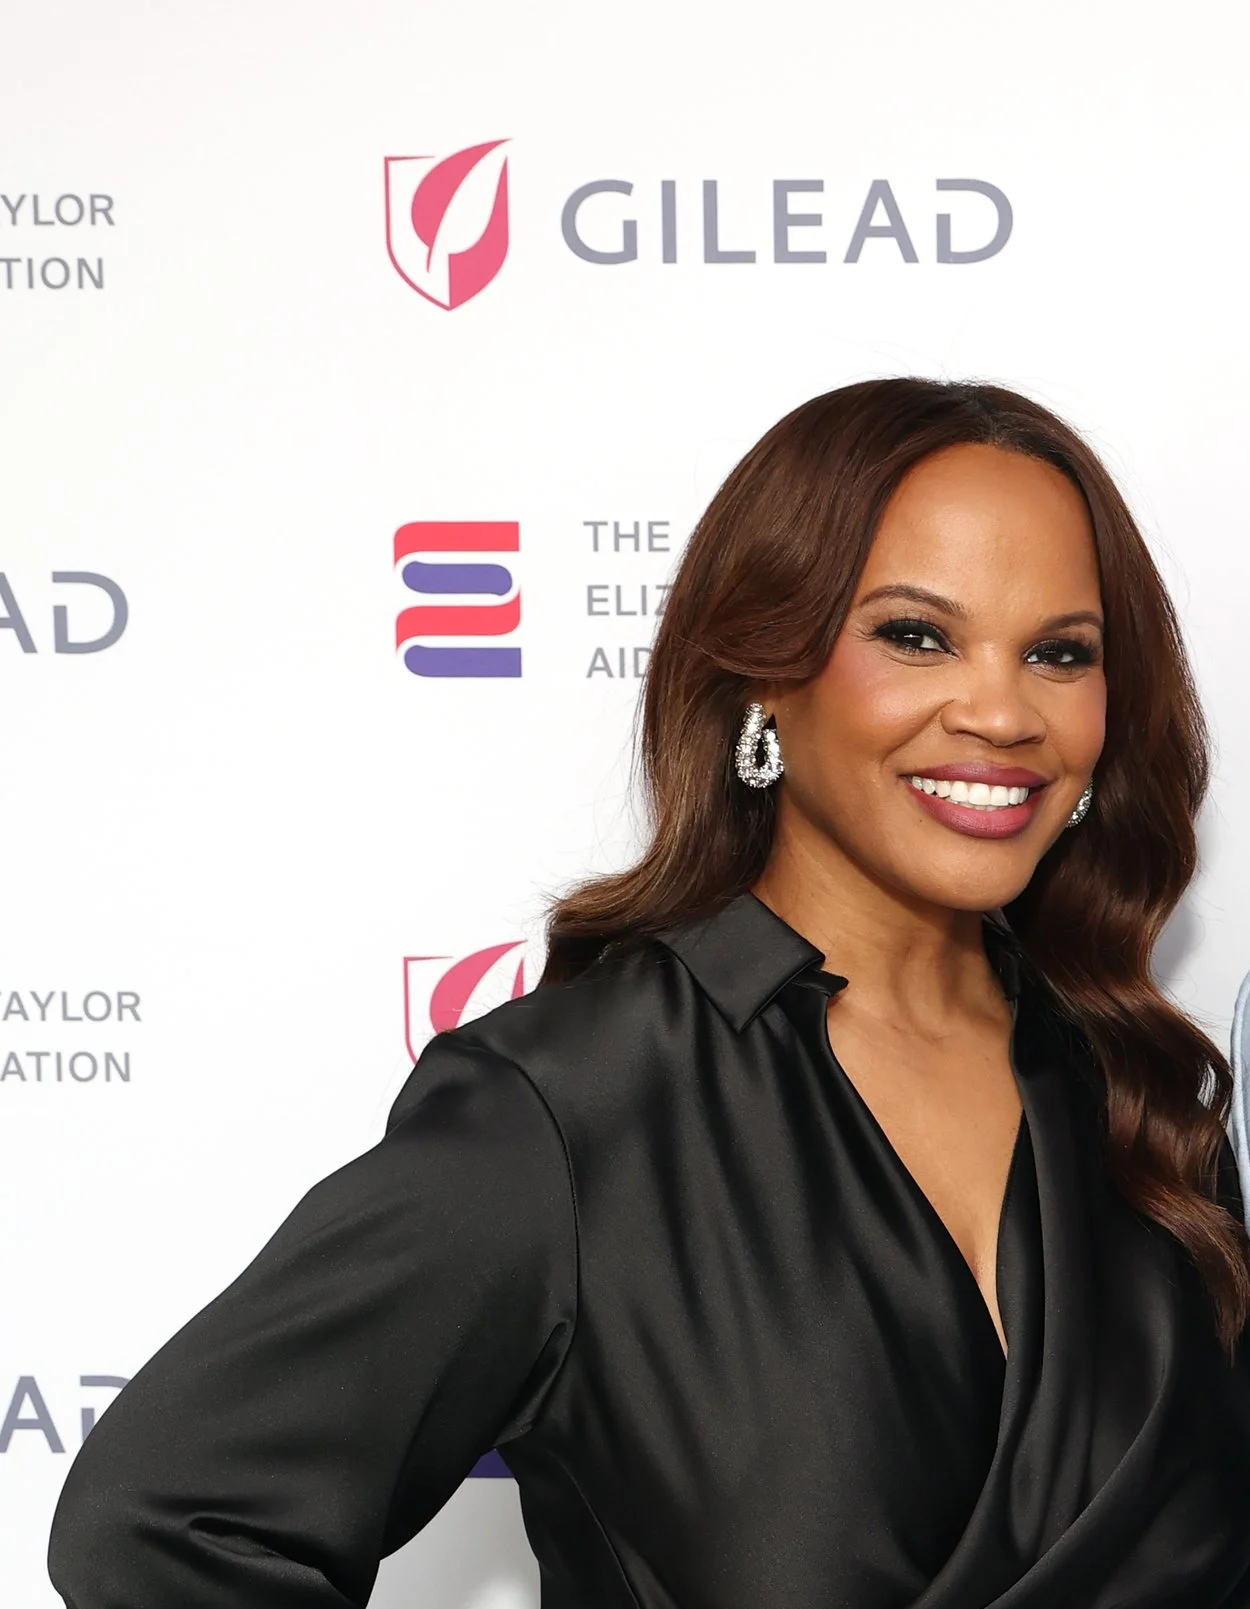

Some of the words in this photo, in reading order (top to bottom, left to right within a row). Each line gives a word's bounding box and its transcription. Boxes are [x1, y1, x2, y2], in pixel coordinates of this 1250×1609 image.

[560, 178, 1014, 266] GILEAD
[583, 520, 671, 553] THE
[0, 990, 142, 1022] AYLOR
